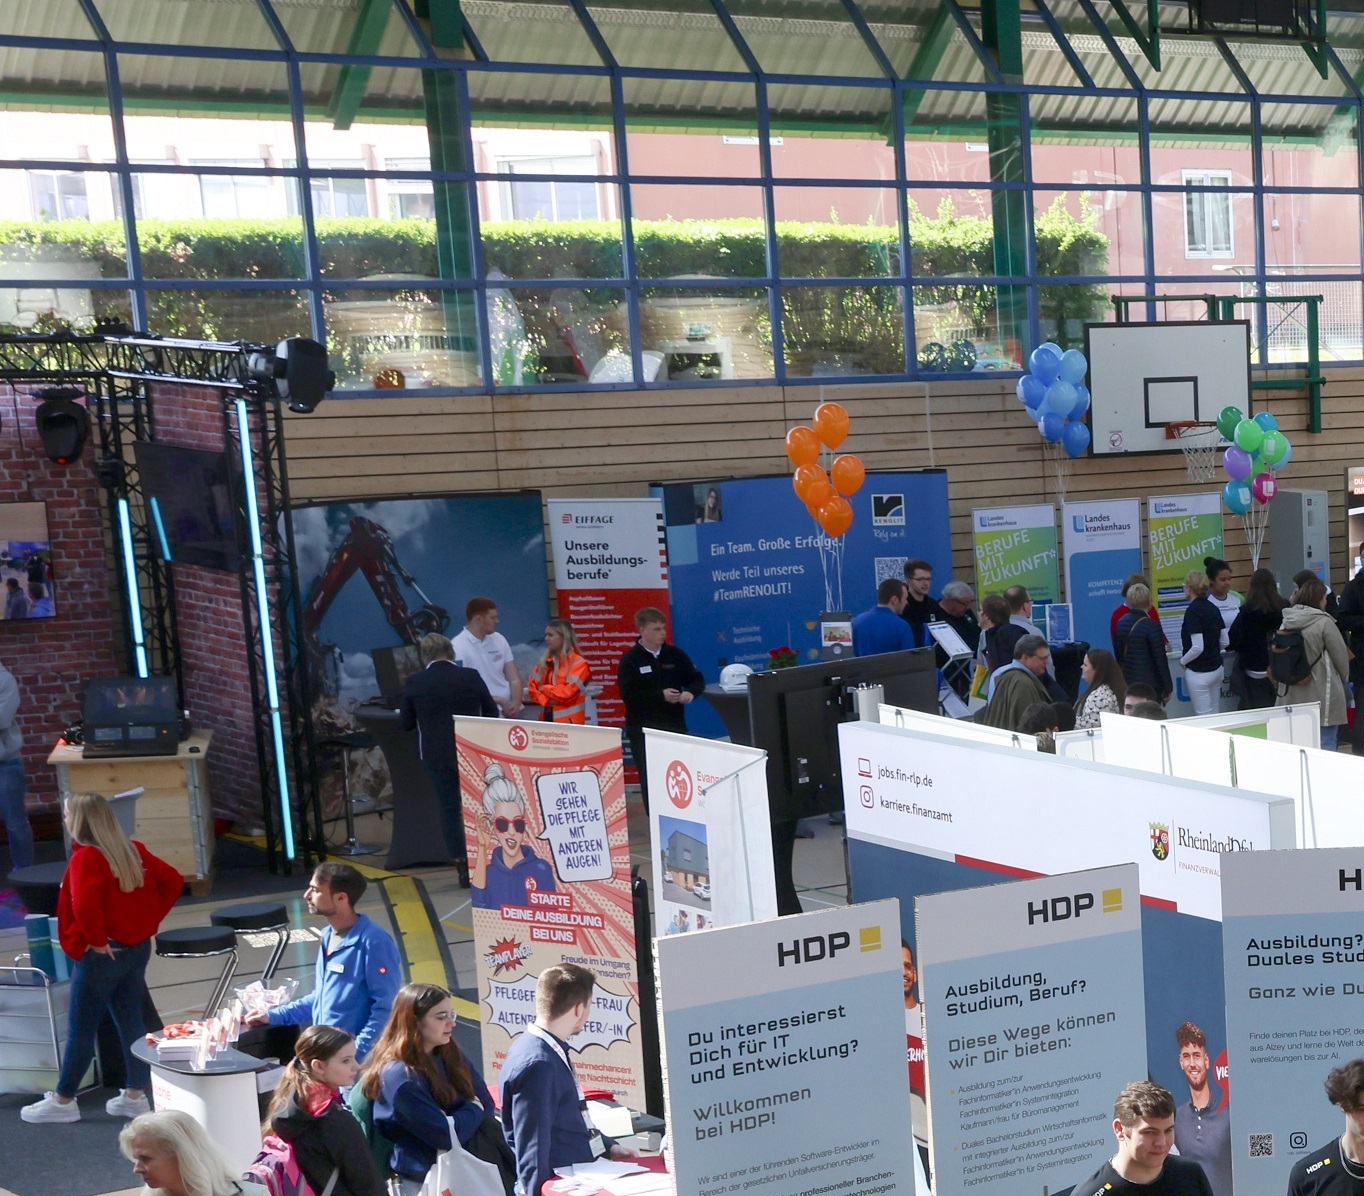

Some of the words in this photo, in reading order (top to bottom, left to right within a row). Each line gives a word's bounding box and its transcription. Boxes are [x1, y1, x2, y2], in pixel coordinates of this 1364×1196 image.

[1354, 478, 1363, 486] DU
[575, 515, 615, 524] EIFFAGE
[987, 520, 1018, 528] krankenhaus
[1084, 514, 1110, 523] Landes
[1085, 522, 1131, 533] krankenhaus
[1150, 515, 1199, 545] BERUFE
[564, 540, 610, 551] Unsere
[710, 543, 726, 557] Ein
[727, 541, 755, 555] Team.
[758, 538, 791, 552] Große
[795, 535, 842, 551] Erfolge.
[975, 529, 1030, 559] BERUFE
[1152, 537, 1176, 557] MIT
[566, 554, 648, 568] Ausbildungs-
[978, 551, 1005, 573] MIT
[711, 568, 741, 583] Werde
[743, 565, 760, 579] Teil
[763, 564, 805, 577] unseres
[713, 581, 793, 602] #TeamRENOLIT!
[531, 730, 569, 739] Evangelische
[531, 737, 570, 747] Sozialstation
[877, 764, 933, 788] jobs.fin-rlp.de
[558, 781, 578, 795] WIR
[555, 796, 588, 811] SEHEN
[879, 795, 953, 824] karriere.finanzamt
[547, 813, 564, 826] DIE
[564, 808, 601, 825] PFLEGE
[569, 825, 586, 839] MIT
[558, 839, 603, 856] ANDEREN
[565, 855, 602, 870] AUGEN!
[530, 892, 571, 907] STARTE
[502, 907, 534, 921] DEINE
[535, 911, 603, 928] AUSBILDUNG
[1027, 892, 1094, 926] HDP
[532, 927, 549, 940] BEI
[549, 928, 574, 943] UNS
[1246, 933, 1364, 951] Ausbildung?
[484, 944, 534, 970] TEAMPLAYER
[777, 931, 851, 968] HDP
[560, 954, 588, 965] Freude
[588, 957, 600, 965] im
[600, 957, 631, 969] Umgang
[1247, 951, 1315, 967] Duales
[944, 971, 1047, 999] Ausbildung,
[1248, 985, 1296, 1000] Ganz
[1302, 982, 1336, 998] wie
[946, 992, 1024, 1017] Studium,
[1029, 979, 1087, 1002] Beruf?
[688, 1030, 714, 1047] Du
[720, 1004, 847, 1041] interessierst
[948, 1032, 997, 1053] Diese
[1002, 1022, 1051, 1042] Wege
[1056, 1010, 1116, 1032] können
[1249, 1031, 1271, 1040] Finde
[1272, 1030, 1298, 1039] deinen
[1299, 1029, 1318, 1038] Platz
[1319, 1028, 1331, 1037] bei
[689, 1045, 731, 1066] Dich
[737, 1038, 767, 1056] für
[773, 1033, 790, 1050] IT
[949, 1054, 979, 1070] wir
[983, 1048, 1009, 1064] Dir
[1014, 1036, 1072, 1059] bieten:
[1249, 1044, 1264, 1052] aus
[1265, 1042, 1285, 1053] Alzey
[690, 1064, 726, 1085] und
[732, 1038, 860, 1077] Entwicklung?
[1249, 1053, 1303, 1064] warelösungen
[1303, 1052, 1316, 1061] bis
[1317, 1053, 1330, 1061] zur
[586, 1073, 637, 1087] Nachtschicht
[957, 1079, 995, 1094] Ausbildung
[996, 1073, 1024, 1086] zum/zur
[692, 1086, 812, 1122] Willkommen
[1022, 1087, 1080, 1106] Systemintegration
[960, 1113, 1009, 1132] Kaufmann/frau
[1010, 1110, 1021, 1121] für
[1021, 1100, 1080, 1121] Büromanagement
[694, 1121, 724, 1141] bei
[729, 1111, 777, 1134] HDP!
[1305, 1160, 1324, 1175] HDP
[856, 1171, 896, 1186] Branchen-
